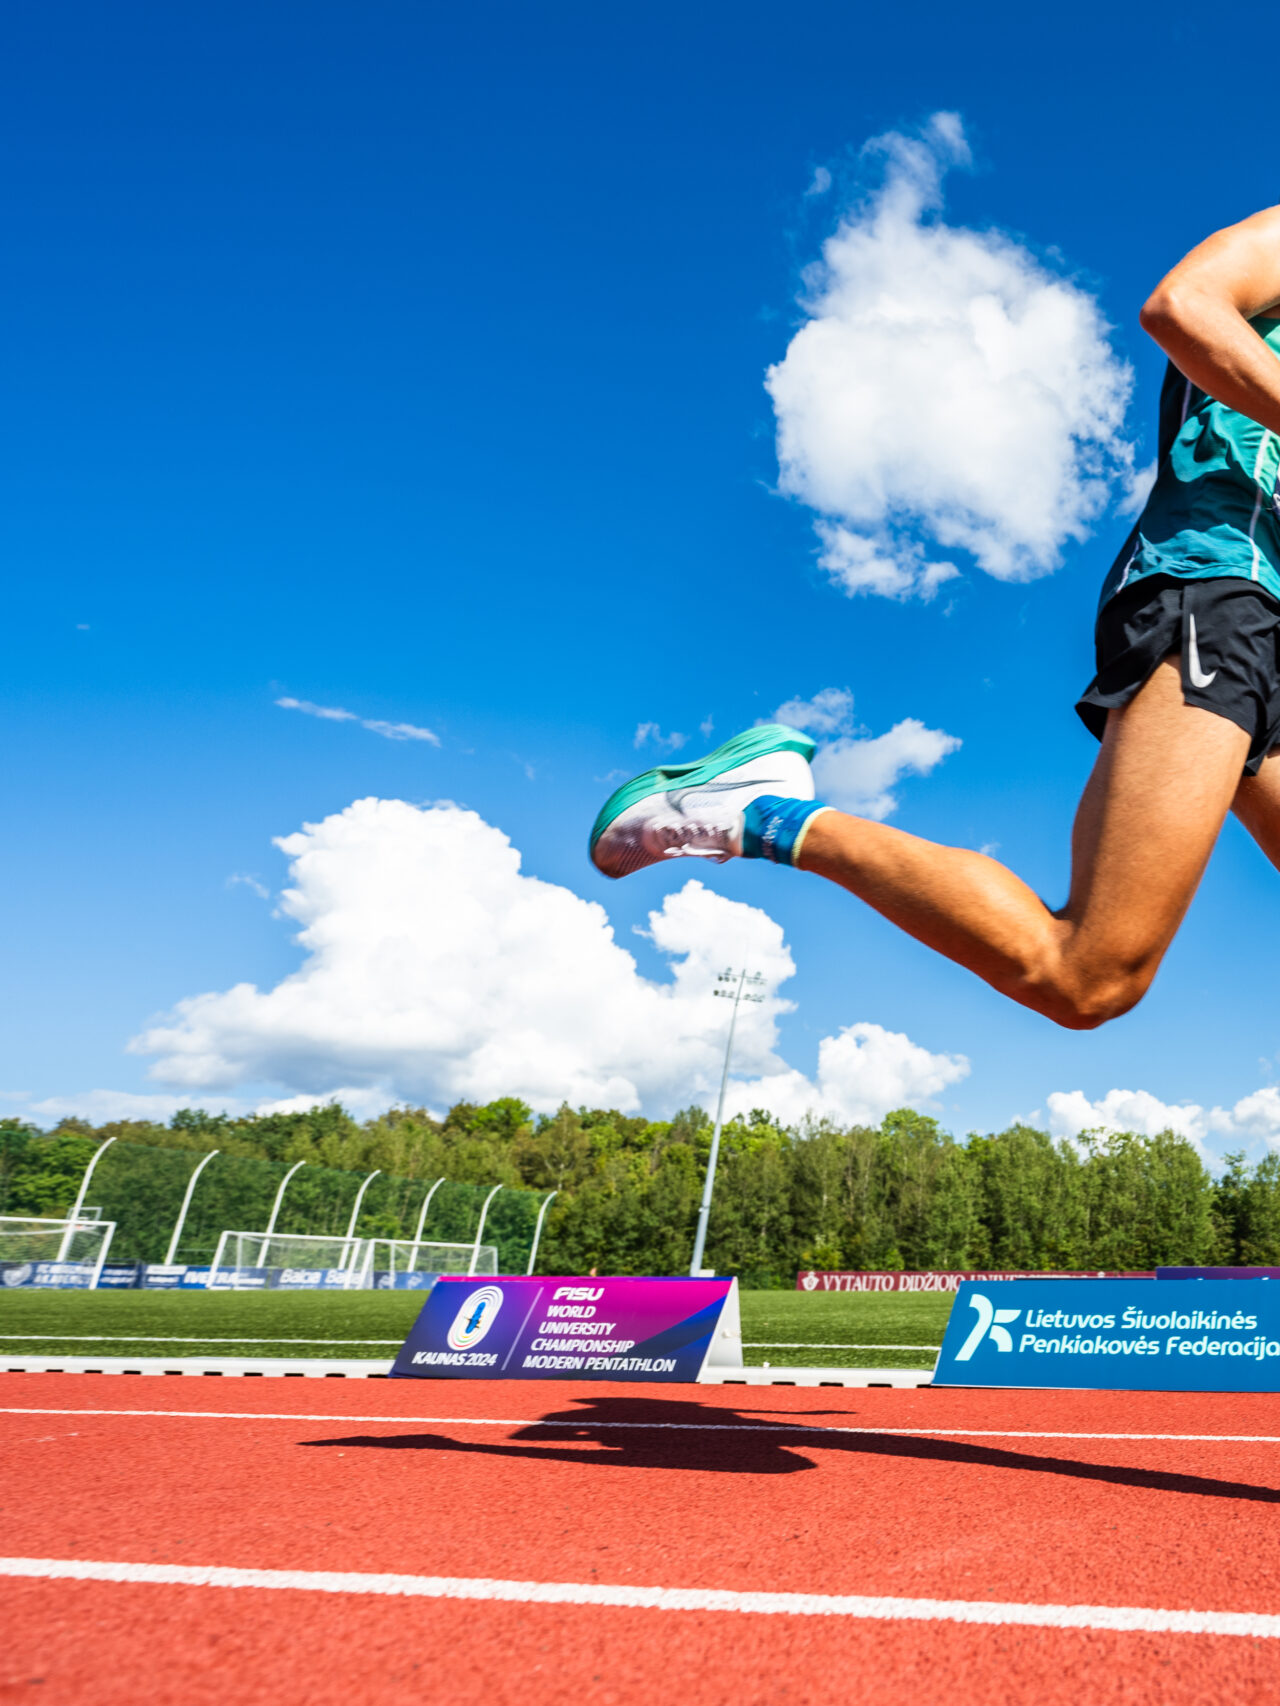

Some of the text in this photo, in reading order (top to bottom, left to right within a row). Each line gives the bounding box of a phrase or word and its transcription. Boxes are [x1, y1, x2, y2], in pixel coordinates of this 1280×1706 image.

[823, 1275, 894, 1291] VYTAUTO
[553, 1287, 605, 1301] FISU
[547, 1305, 596, 1318] WORLD
[1025, 1306, 1258, 1330] Lietuvos Šiuolaikinės
[539, 1322, 616, 1335] UNIVERSITY
[530, 1338, 635, 1353] CHAMPIONSHIP
[1020, 1334, 1280, 1360] Penkiakovės Federacija
[411, 1352, 498, 1366] KAUNAS 2024
[522, 1355, 676, 1371] MODERN PENTATHLON
